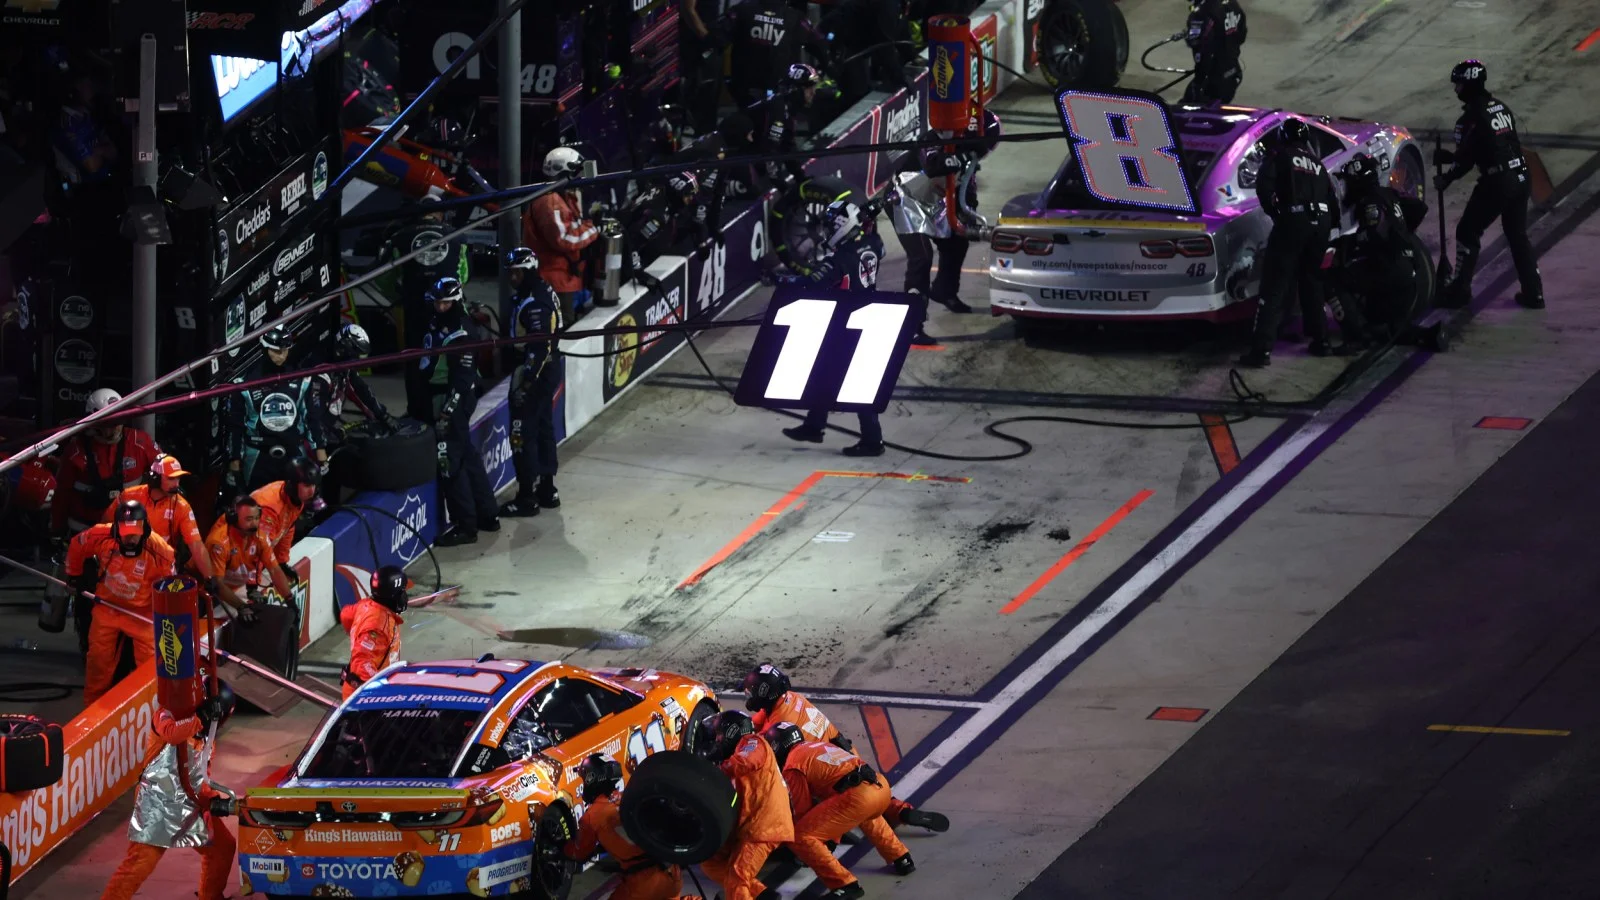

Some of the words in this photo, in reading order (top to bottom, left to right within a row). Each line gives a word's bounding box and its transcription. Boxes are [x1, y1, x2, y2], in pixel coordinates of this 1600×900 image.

[3, 16, 60, 25] CHEVROLET
[751, 23, 785, 46] ally
[520, 63, 557, 94] 48
[936, 46, 949, 98] SUNOCO
[1465, 66, 1479, 80] 48
[1491, 112, 1513, 131] ally
[1060, 90, 1196, 211] 8
[1293, 156, 1322, 177] ally
[236, 199, 271, 245] Cheddar's
[278, 233, 315, 272] BENNETT
[696, 241, 727, 309] 48
[1032, 259, 1168, 271] ally.com/sweepstakes/nascar
[1186, 262, 1206, 277] 48
[1040, 287, 1150, 301] CHEVROLET
[764, 299, 910, 405] 11
[391, 514, 415, 554] LUCAS
[416, 503, 428, 534] OIL
[395, 578, 402, 588] 11
[163, 621, 176, 674] SUNOCO
[628, 718, 666, 766] 11
[50, 693, 159, 835] Hawaiia
[304, 829, 341, 843] King's
[342, 830, 403, 843] Hawaiian
[490, 821, 521, 843] BOB'S
[438, 834, 461, 852] 11
[252, 861, 273, 871] Mobil
[318, 863, 398, 879] TOYOTA
[488, 860, 528, 881] PROGRESSIVE
